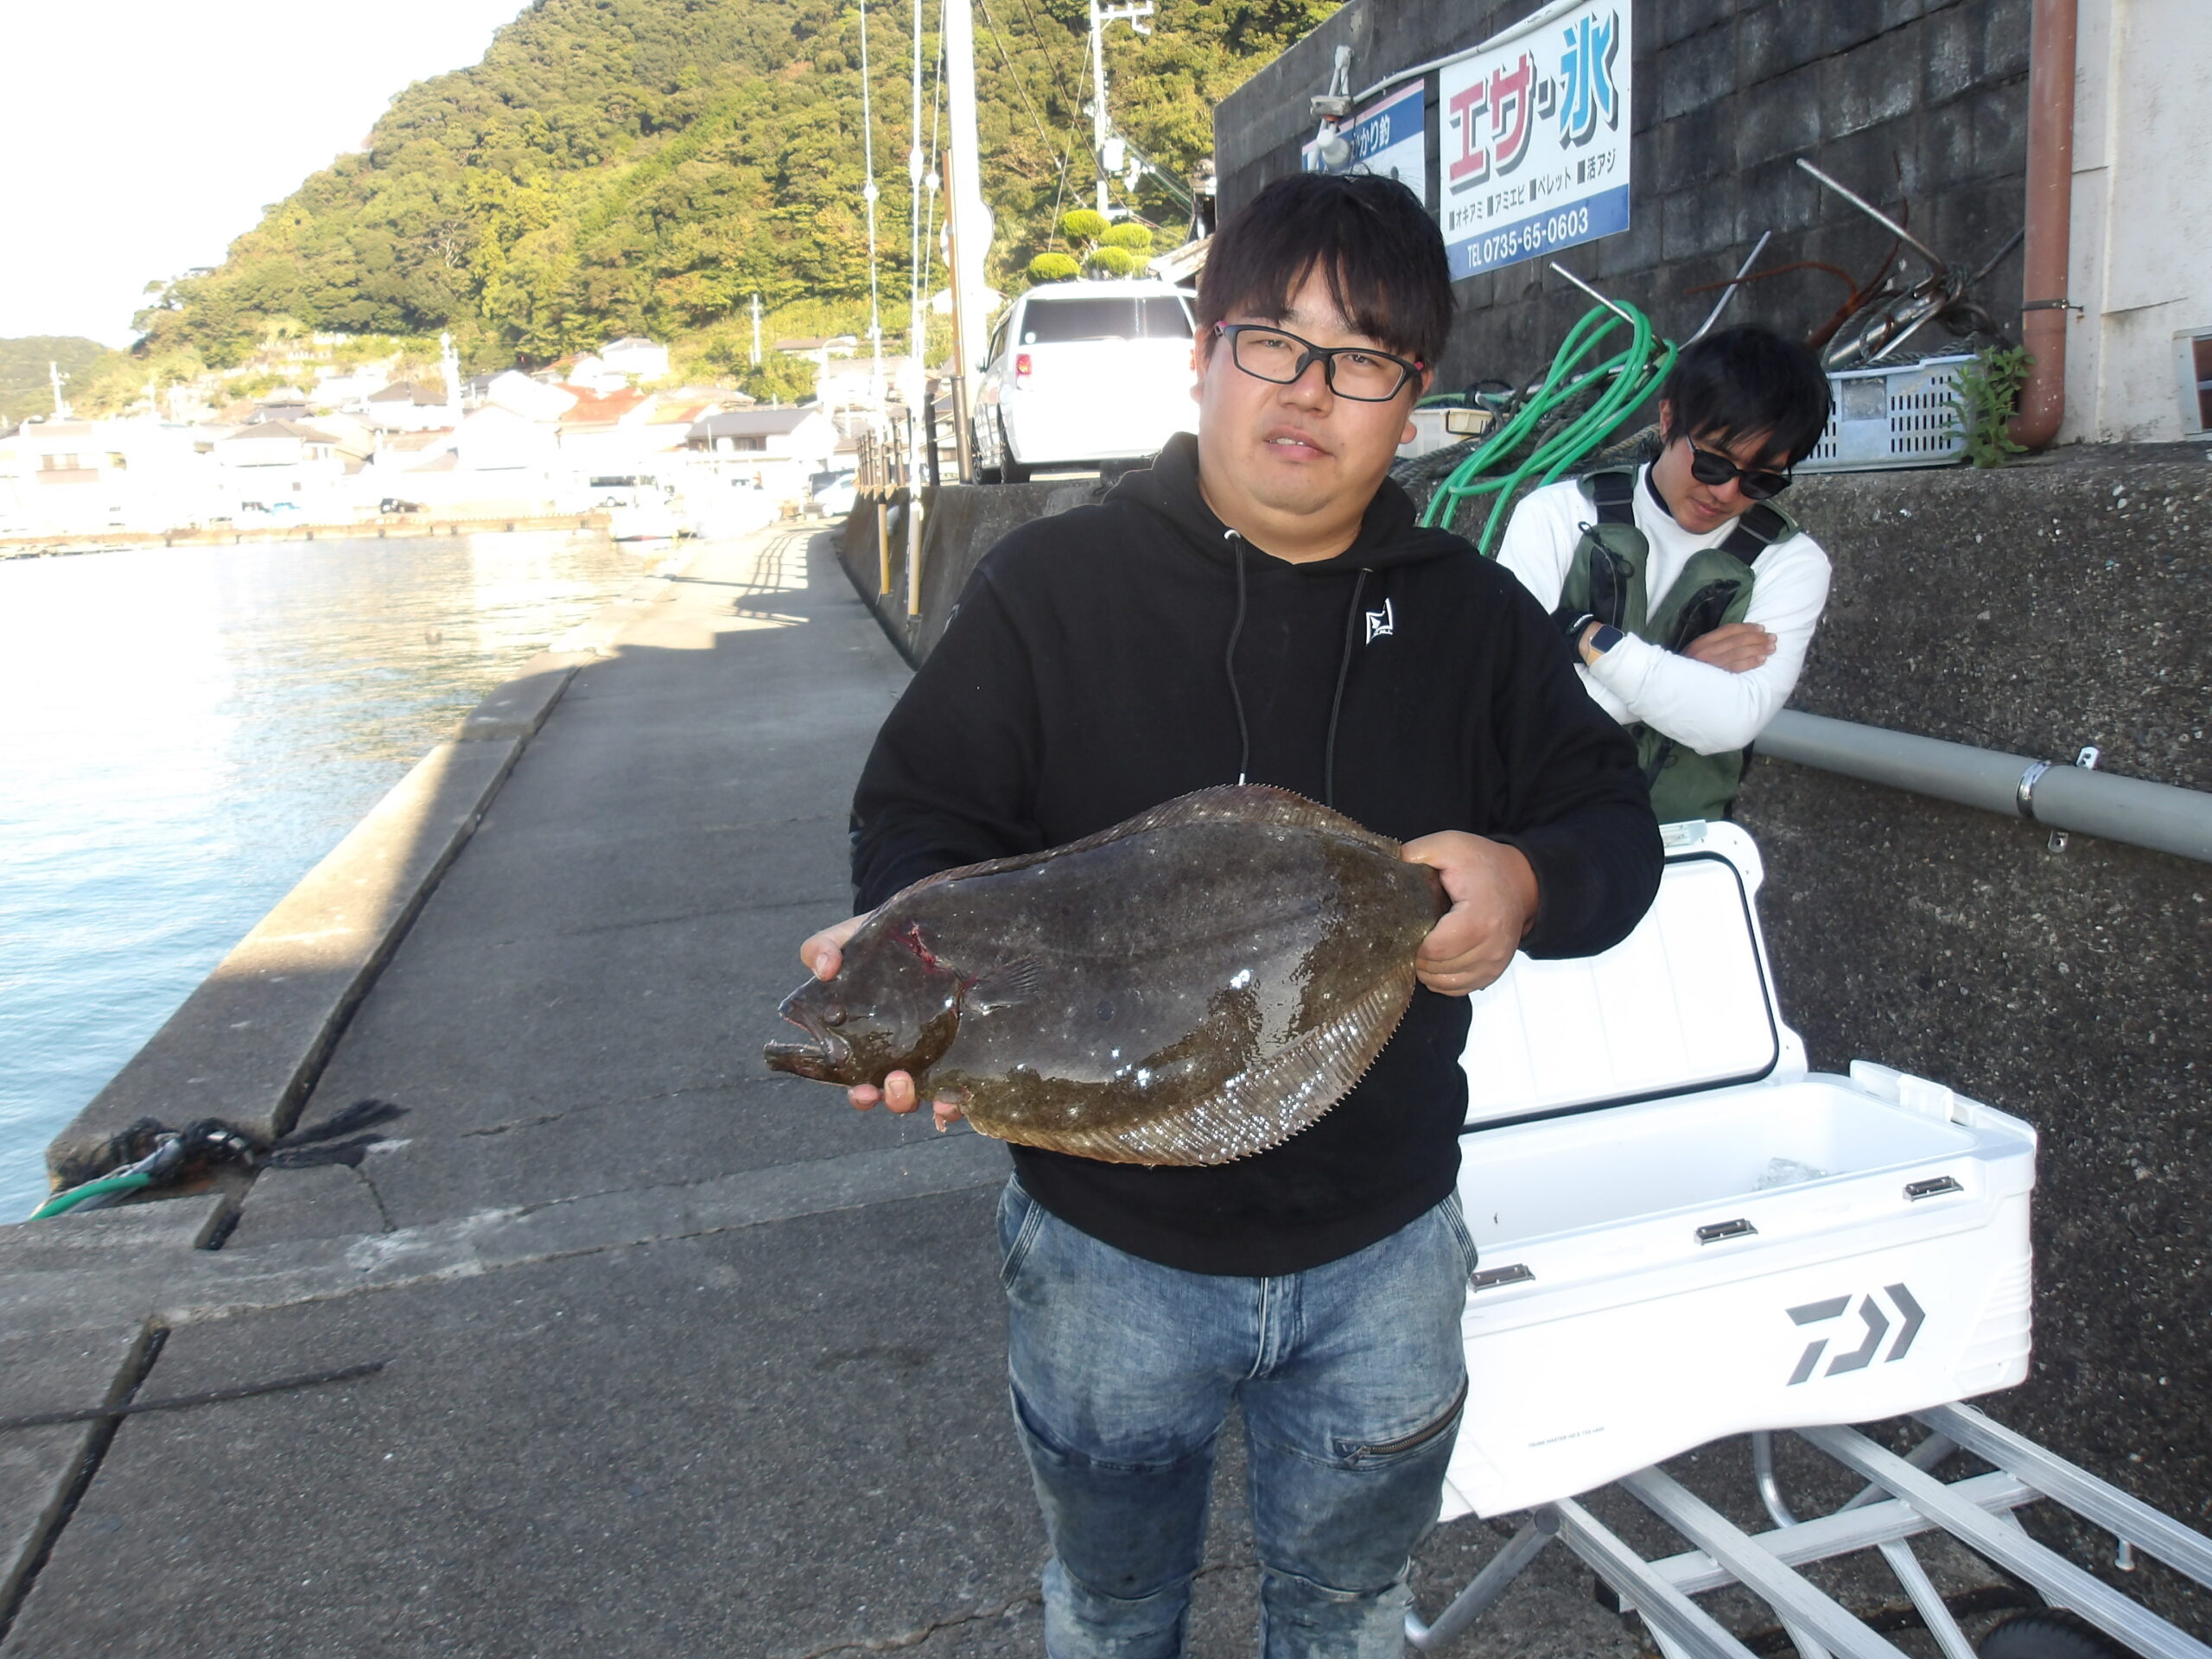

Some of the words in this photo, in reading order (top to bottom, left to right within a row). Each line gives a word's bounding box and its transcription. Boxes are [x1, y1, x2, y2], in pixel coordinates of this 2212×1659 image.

[1455, 199, 1484, 229] オキアミ
[1586, 148, 1616, 180] 活アジ
[1467, 244, 1482, 269] TEL
[1483, 207, 1588, 263] 0735-65-0603
